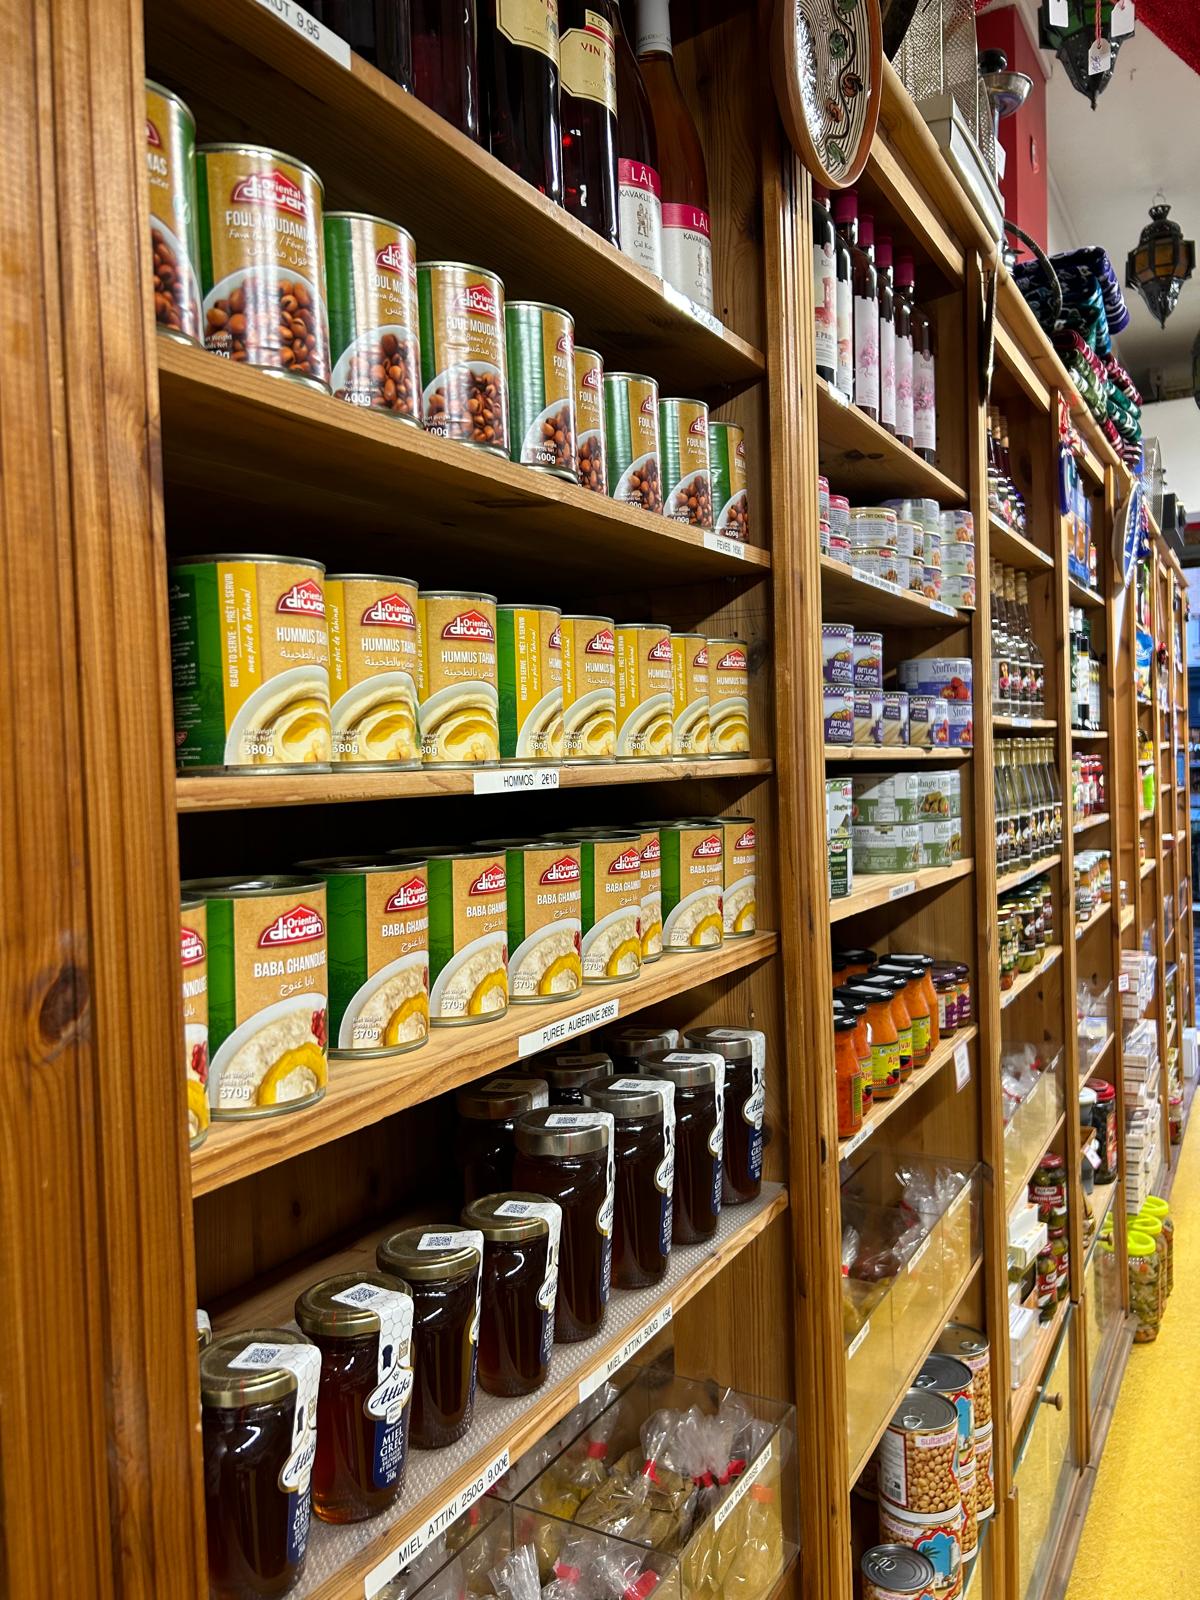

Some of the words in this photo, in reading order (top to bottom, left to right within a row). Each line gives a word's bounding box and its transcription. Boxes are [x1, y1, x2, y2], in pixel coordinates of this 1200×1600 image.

[296, 12, 320, 40] 9.95
[580, 42, 601, 56] VIN
[631, 167, 654, 188] LÂL
[225, 211, 255, 228] FOUL
[692, 212, 709, 233] LÂL
[553, 356, 568, 370] FOUL
[344, 392, 371, 407] 400g
[579, 391, 593, 402] FOUL
[638, 417, 651, 428] FOUL
[687, 438, 699, 448] FOUL
[536, 453, 556, 464] 400g
[224, 573, 235, 598] SERVIR
[225, 606, 236, 623] PRÊT
[371, 601, 414, 622] diwan
[385, 603, 411, 615] Oriental
[243, 624, 253, 634] de
[450, 617, 492, 637] diwan
[464, 618, 490, 628] Oriental
[276, 627, 316, 643] HUMMUS
[332, 636, 341, 645] de
[227, 631, 238, 654] SERVE
[244, 636, 256, 654] plus
[361, 638, 400, 652] HUMMUS
[228, 653, 238, 663] TO
[333, 647, 343, 663] plus
[441, 651, 477, 664] HUMMUS
[247, 656, 255, 673] avec
[585, 662, 609, 674] HUMMUS
[932, 663, 958, 674] Stuffed
[228, 665, 240, 688] READY
[245, 744, 274, 756] 380g
[332, 743, 359, 755] 380g
[503, 774, 533, 787] HOMMOS
[541, 773, 557, 784] 2€10
[733, 857, 745, 865] BABA
[690, 865, 705, 874] BABA
[605, 883, 623, 893] BABA
[537, 894, 557, 905] BABA
[466, 906, 486, 917] BABA
[287, 915, 316, 928] Oriental
[269, 917, 322, 941] diwan
[382, 923, 405, 937] BABA
[254, 960, 284, 978] BABA
[583, 962, 602, 972] 370g
[513, 980, 535, 990] 370g
[441, 1000, 464, 1010] 370g
[543, 1024, 565, 1042] PUREE
[568, 1009, 600, 1032] AUBERINE
[353, 1028, 380, 1040] 370g
[219, 1086, 250, 1101] 370g
[607, 1357, 622, 1373] MIEL
[623, 1334, 643, 1359] ATTIKI
[644, 1319, 658, 1339] 500G
[371, 1373, 411, 1410] Attiki
[381, 1427, 403, 1448] MIEL
[380, 1436, 404, 1457] GREC
[398, 1538, 423, 1565] MIEL
[427, 1504, 457, 1539] ATTIKI
[461, 1478, 483, 1507] 250G
